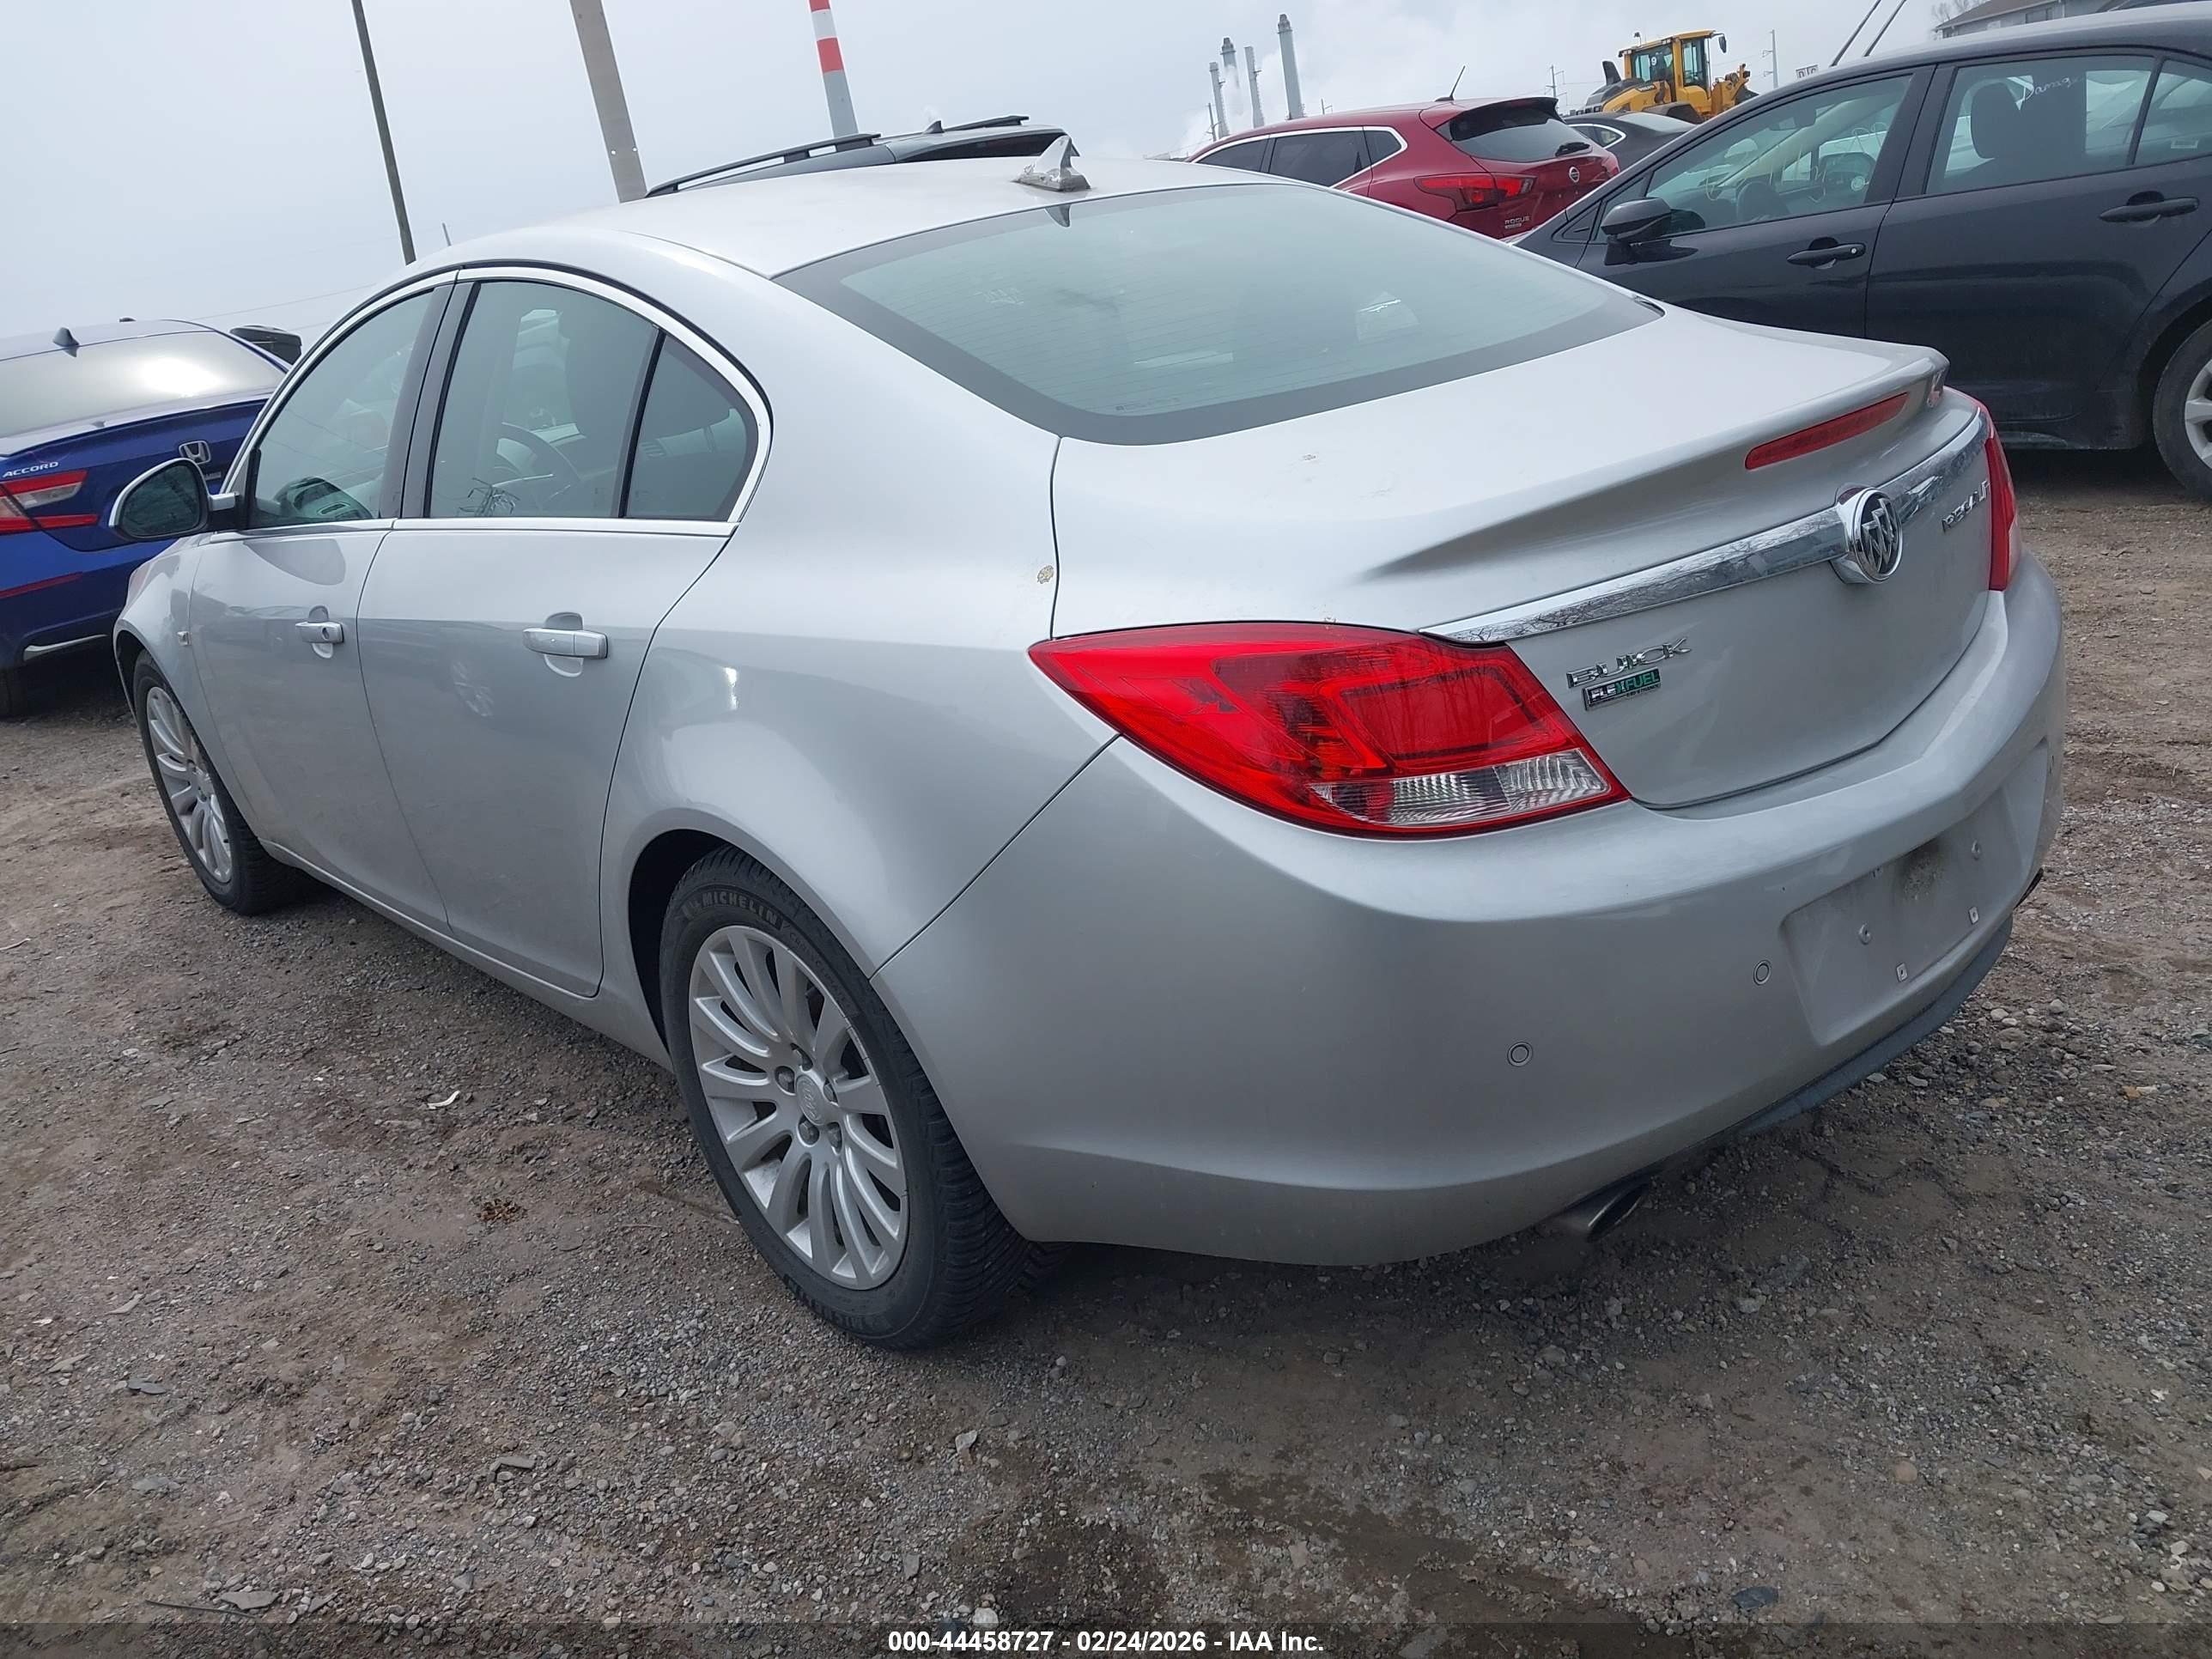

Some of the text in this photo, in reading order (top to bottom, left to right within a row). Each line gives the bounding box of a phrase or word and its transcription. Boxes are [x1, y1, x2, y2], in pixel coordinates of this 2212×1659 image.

[3, 461, 59, 478] ACCORD
[1566, 638, 1692, 689] BUICK
[1589, 672, 1660, 699] FLEXFUEL
[702, 891, 779, 927] MICHELIN
